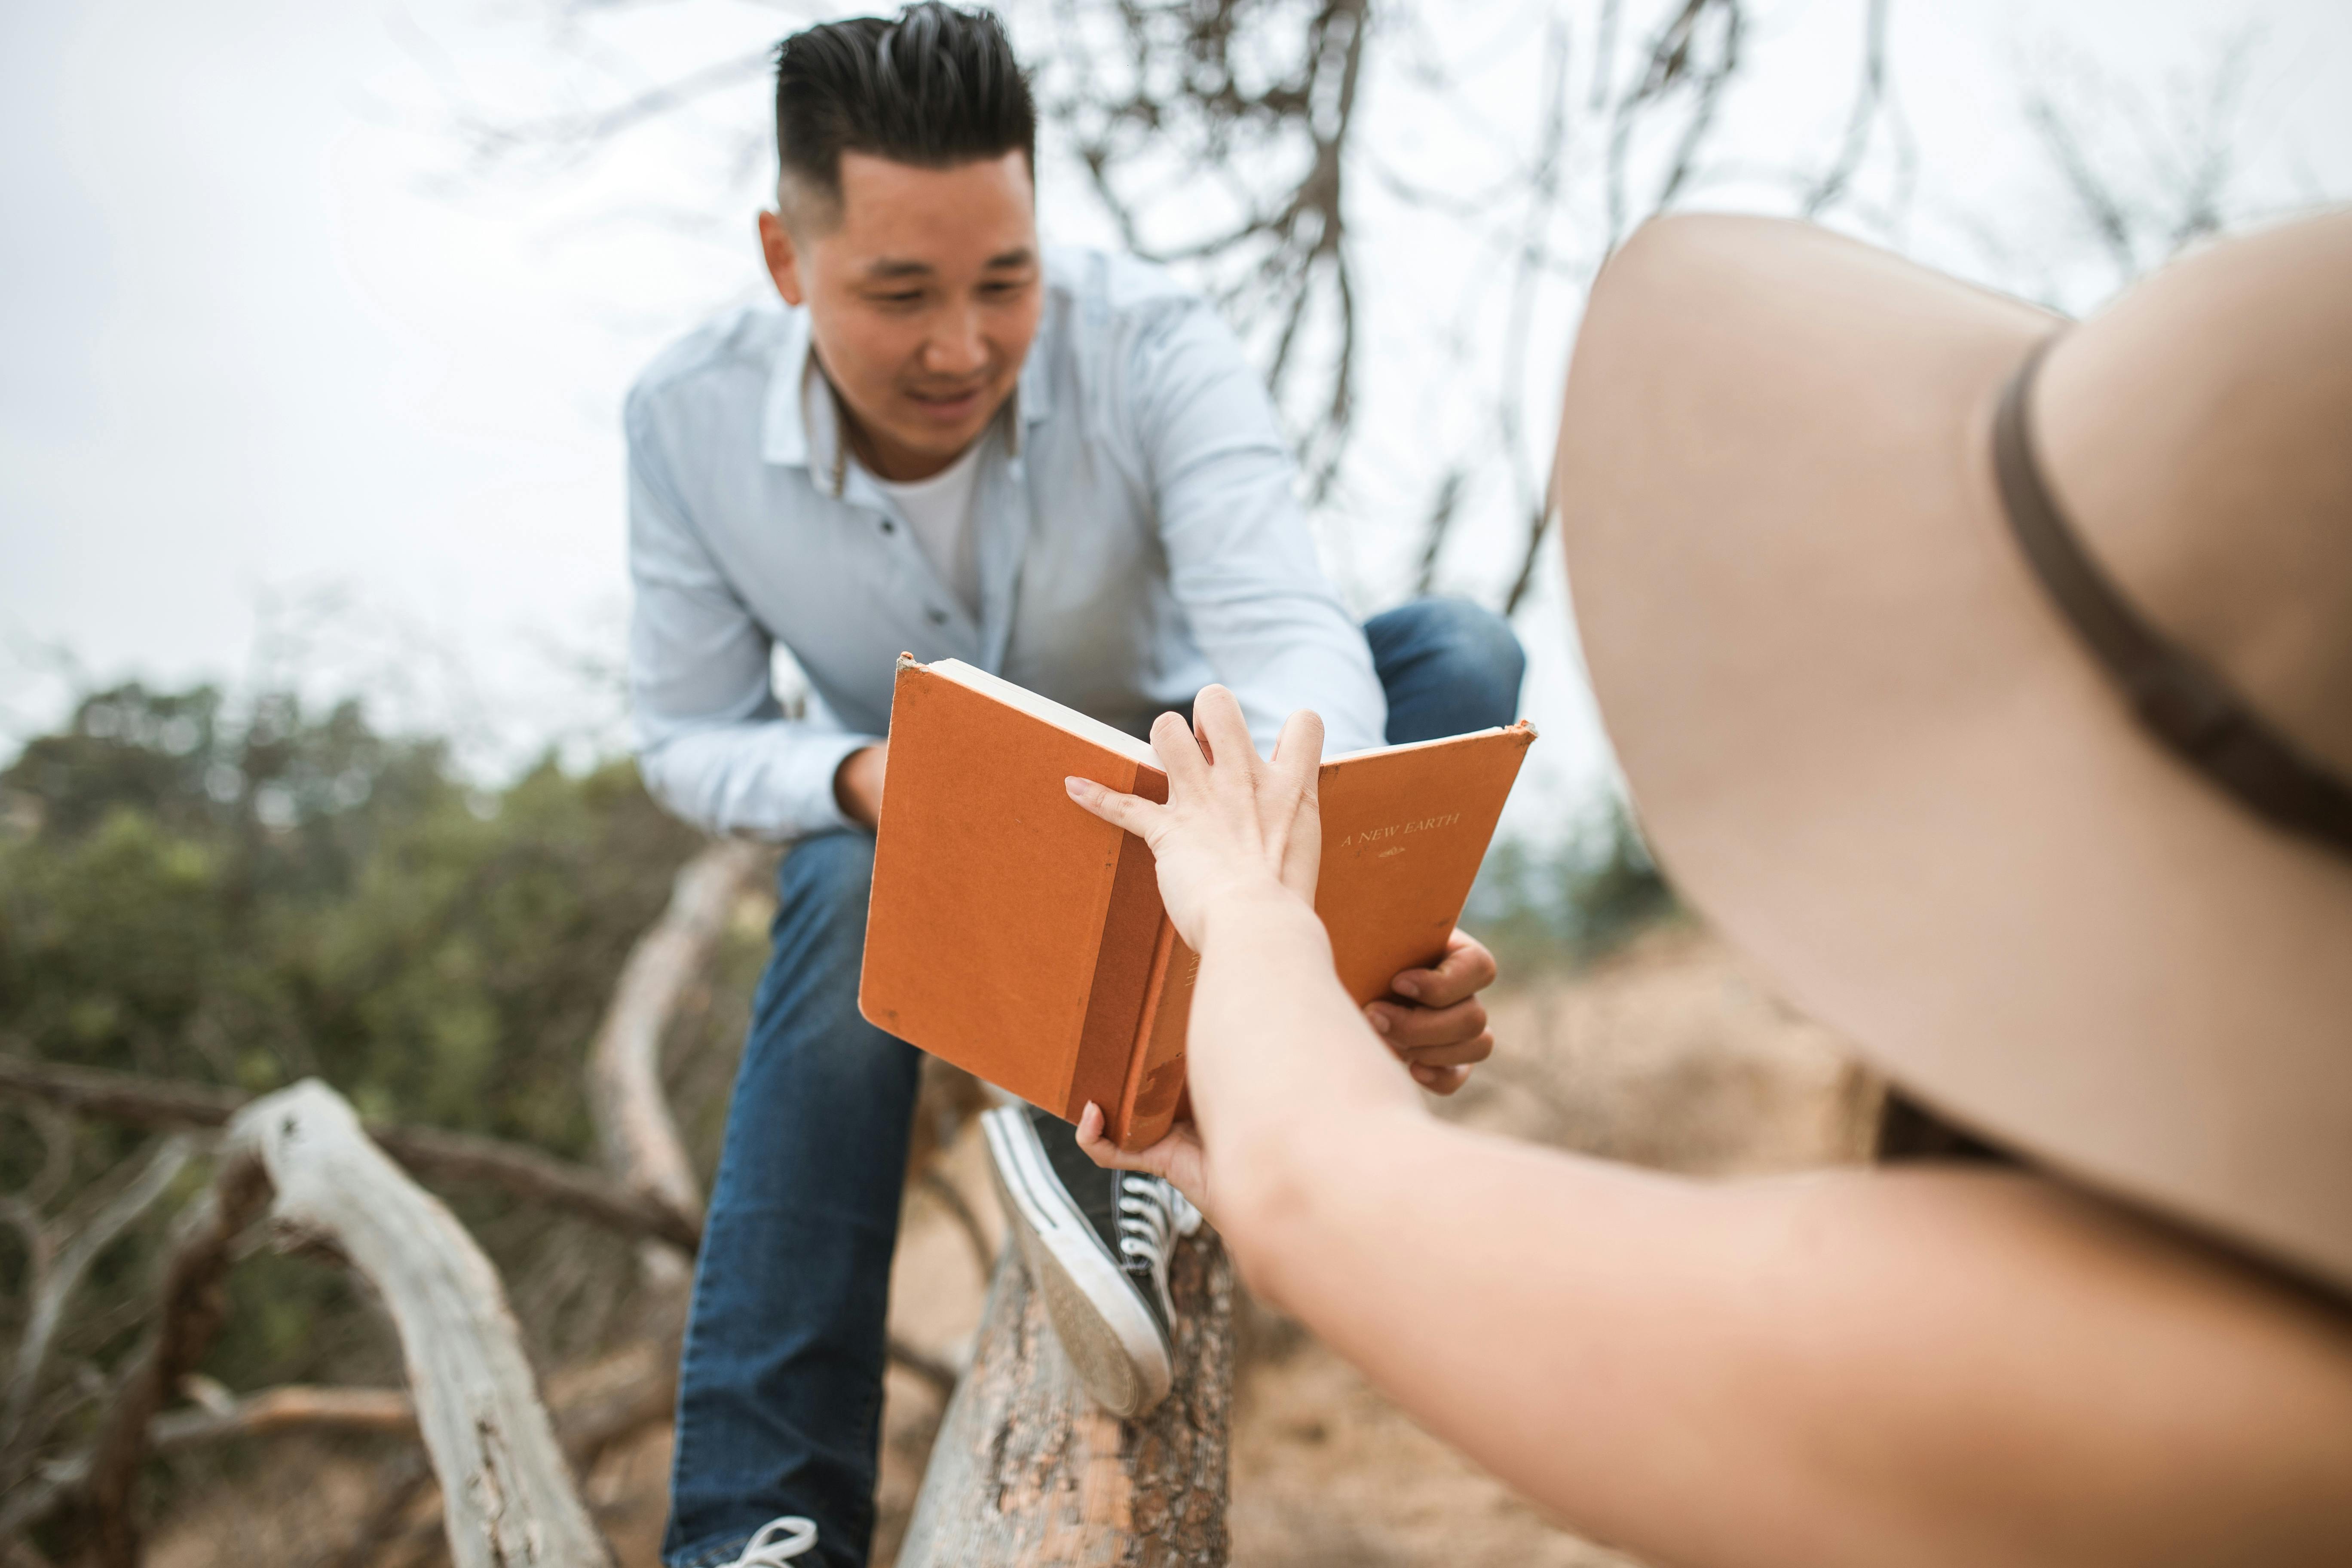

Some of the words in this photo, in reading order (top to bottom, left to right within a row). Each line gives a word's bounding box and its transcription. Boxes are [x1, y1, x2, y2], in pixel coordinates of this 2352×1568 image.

[1341, 835, 1351, 847] A
[1358, 824, 1400, 843] NEW
[1404, 812, 1461, 834] EARTH
